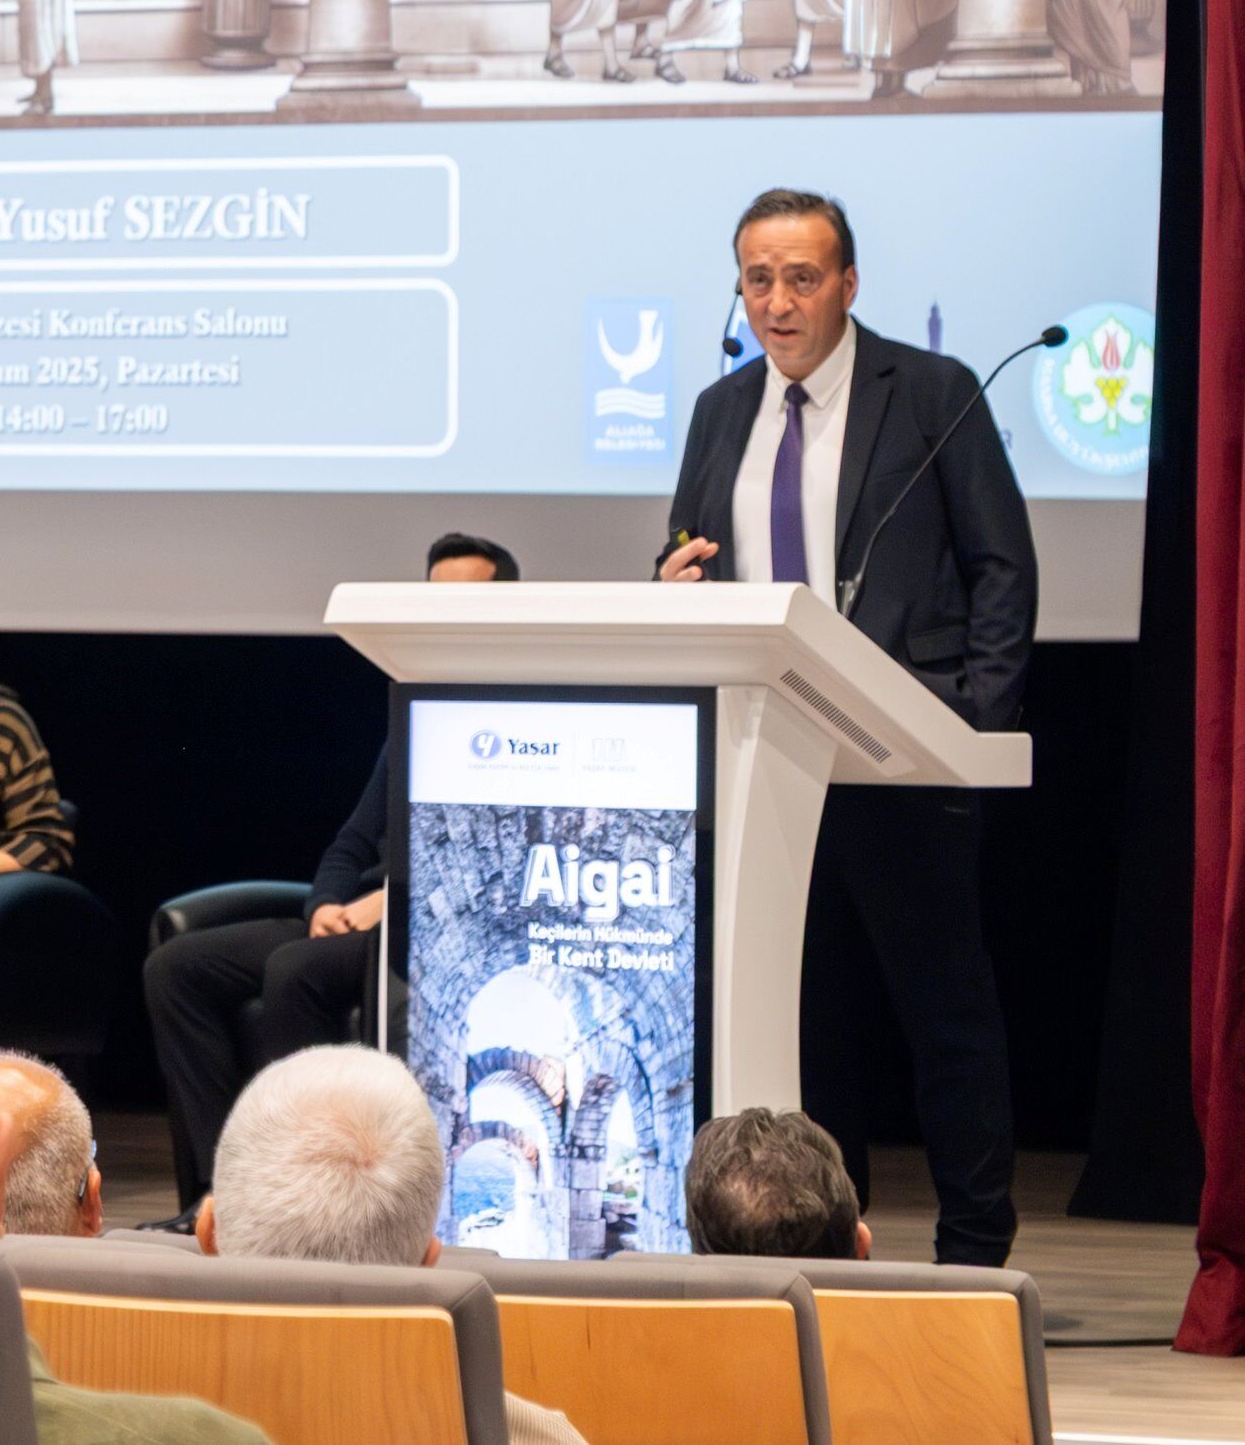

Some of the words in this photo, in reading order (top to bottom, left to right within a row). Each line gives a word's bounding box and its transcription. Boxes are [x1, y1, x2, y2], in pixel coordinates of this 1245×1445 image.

[123, 187, 311, 241] SEZGİN
[48, 307, 189, 338] Konferans
[193, 307, 289, 336] Salonu
[36, 355, 109, 391] 2025,
[117, 355, 241, 385] Pazartesi
[97, 403, 168, 432] 17:00
[520, 843, 677, 922] Aigai
[559, 946, 604, 968] Kent
[607, 947, 675, 971] Devleti
